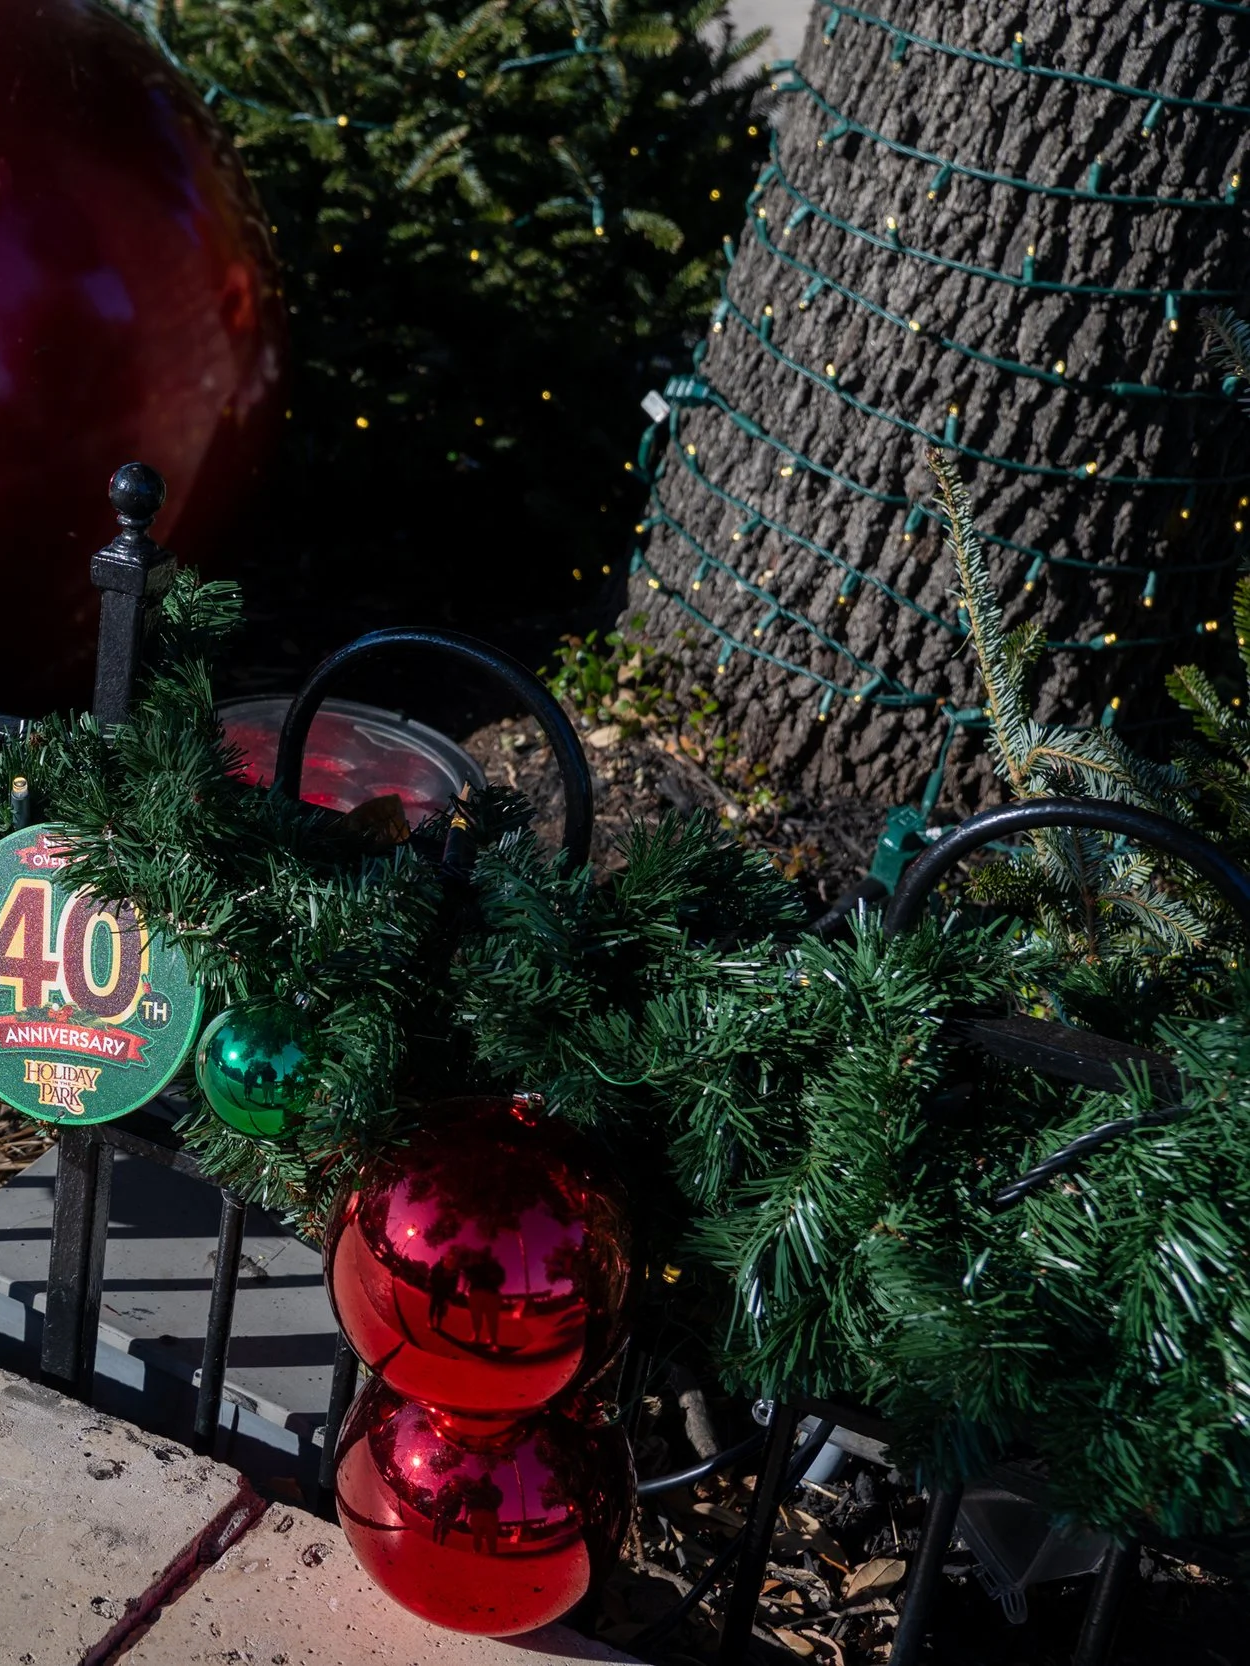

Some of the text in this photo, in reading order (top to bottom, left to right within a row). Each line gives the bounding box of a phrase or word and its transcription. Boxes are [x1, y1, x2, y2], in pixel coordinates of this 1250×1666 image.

[141, 1001, 167, 1022] TH
[5, 1026, 125, 1056] ANNIVERSARY
[26, 1061, 99, 1089] HOLIDAY
[42, 1082, 83, 1113] PARK
